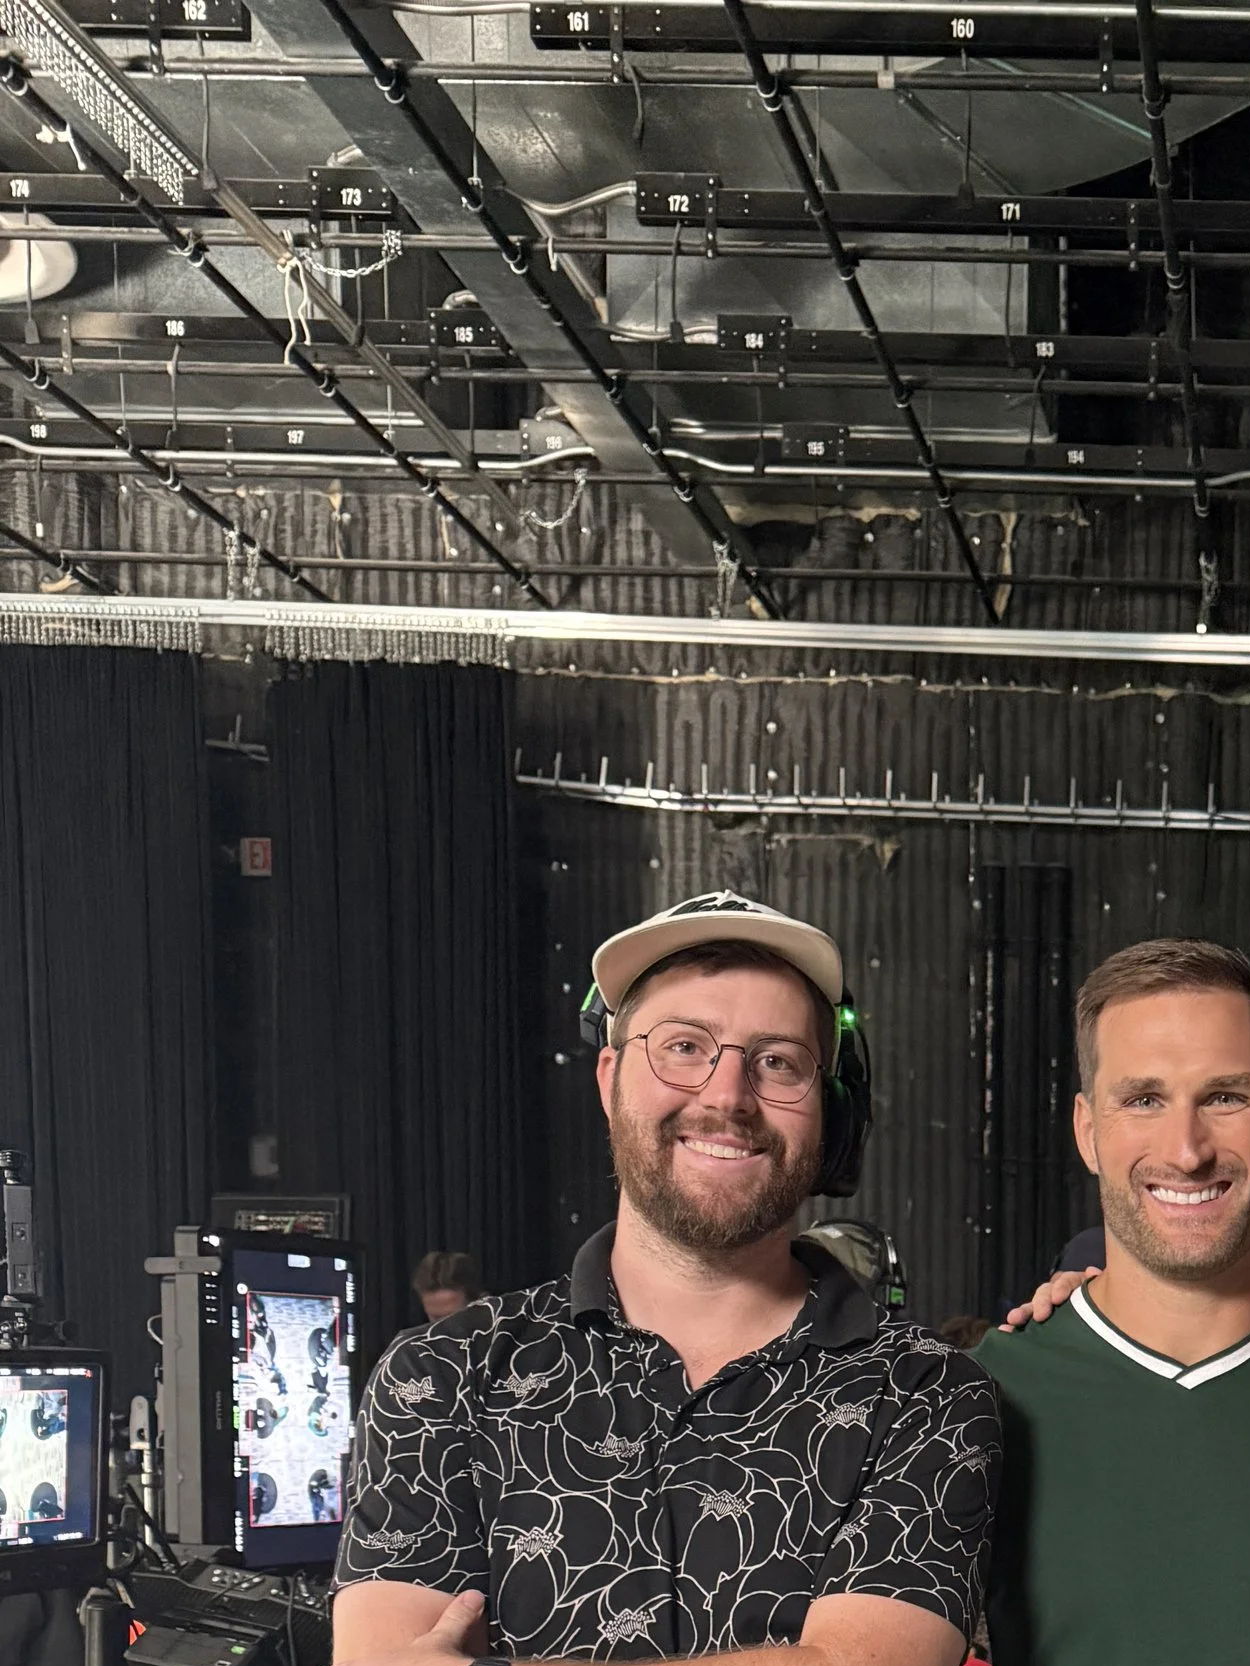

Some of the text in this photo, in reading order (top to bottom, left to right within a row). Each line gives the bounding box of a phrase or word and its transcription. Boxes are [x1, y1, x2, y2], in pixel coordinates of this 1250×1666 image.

[182, 0, 207, 21] 162
[566, 11, 590, 32] 161
[950, 18, 975, 39] 160
[9, 179, 30, 198] 174
[340, 187, 362, 207] 173
[667, 194, 689, 213] 172
[1001, 202, 1021, 220] 171
[165, 319, 185, 337] 186
[454, 326, 474, 343] 185
[744, 333, 764, 349] 184
[29, 424, 48, 439] 198
[287, 429, 305, 445] 197
